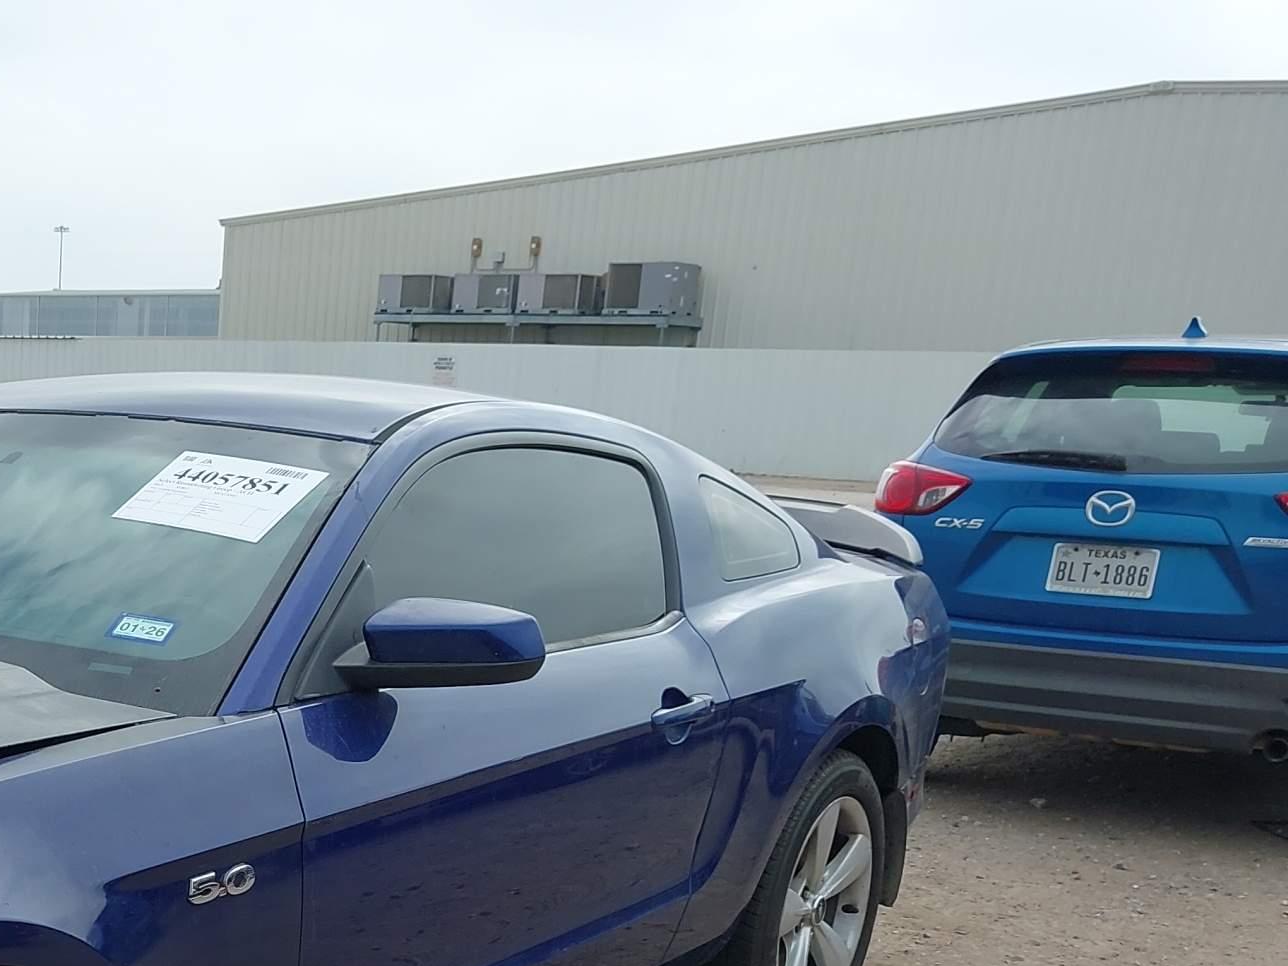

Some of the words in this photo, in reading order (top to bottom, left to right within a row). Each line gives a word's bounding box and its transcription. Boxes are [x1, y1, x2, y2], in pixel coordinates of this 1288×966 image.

[173, 467, 291, 496] 44057851
[934, 516, 985, 529] CX-5
[1087, 549, 1127, 560] TEXAS
[186, 863, 256, 905] 5.0
